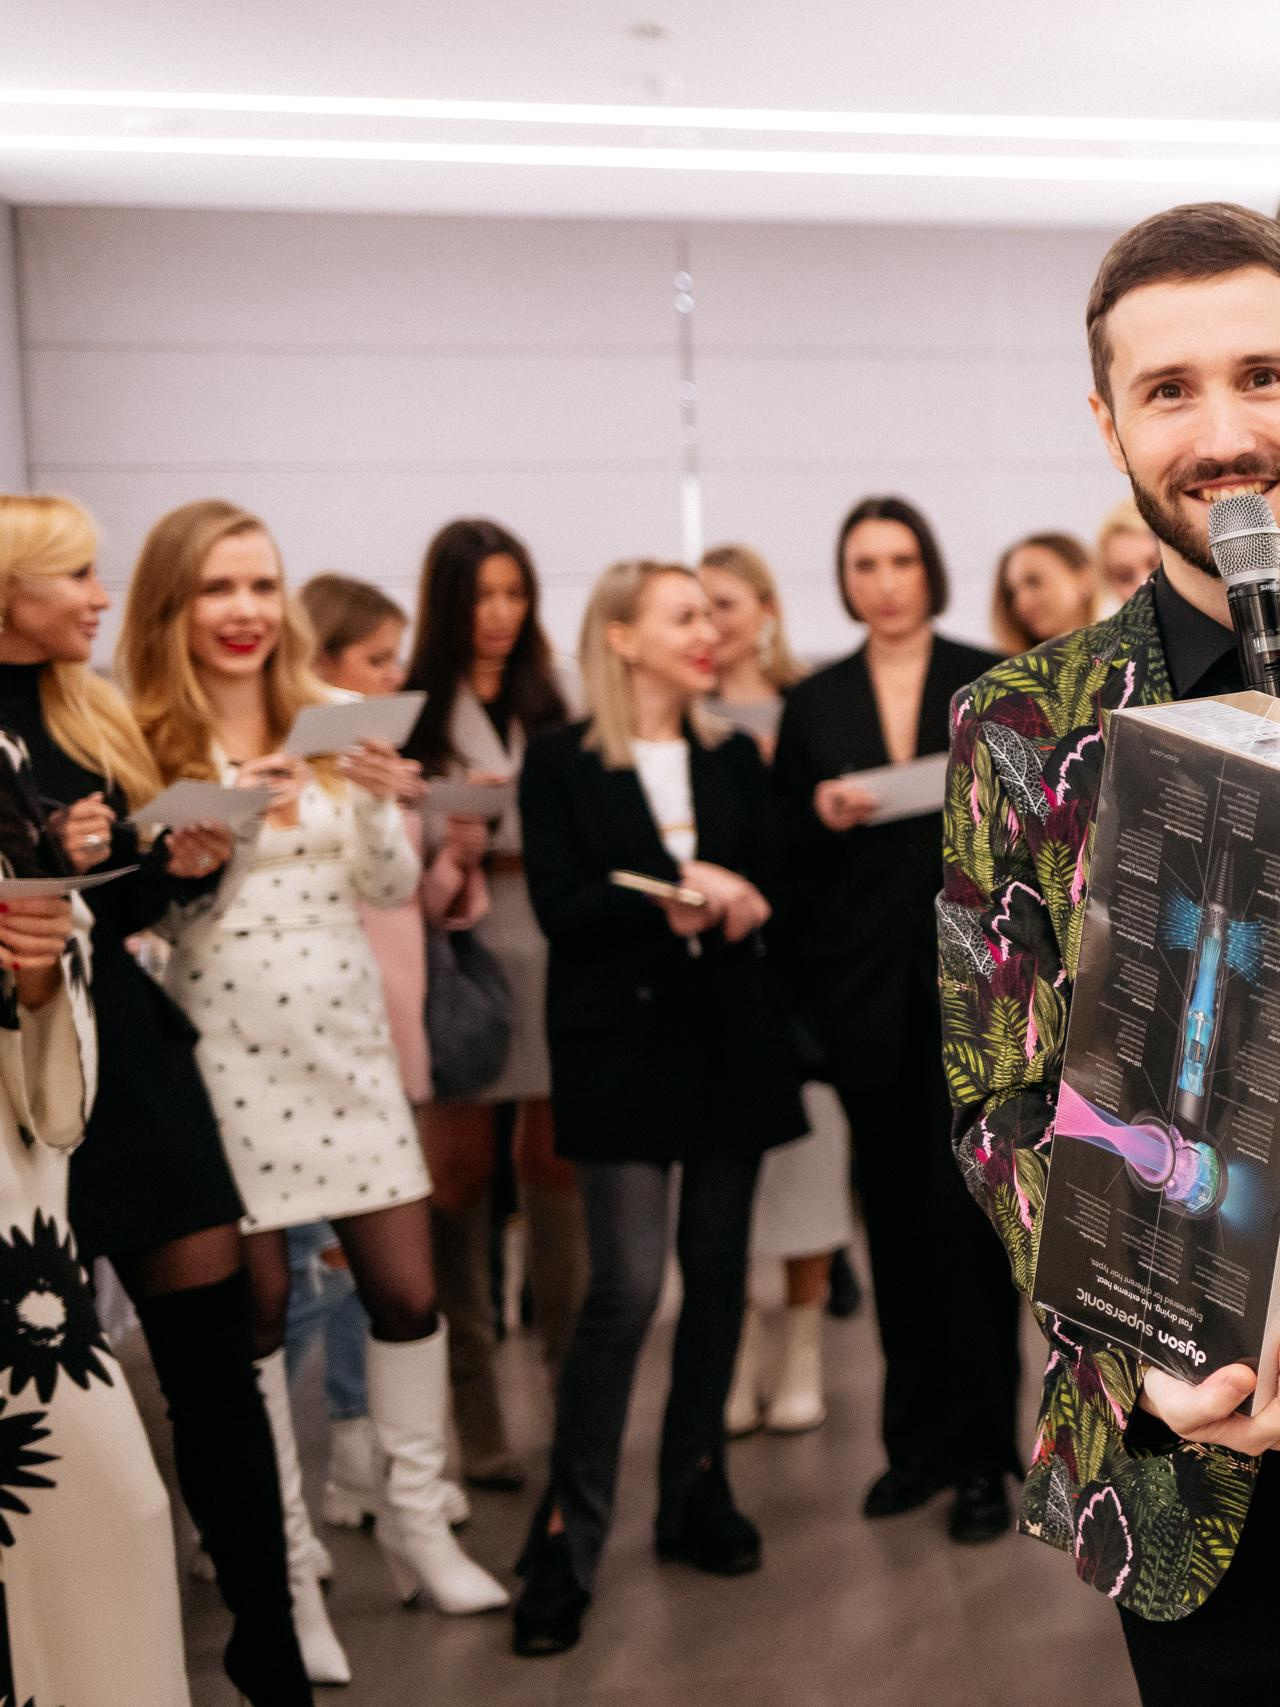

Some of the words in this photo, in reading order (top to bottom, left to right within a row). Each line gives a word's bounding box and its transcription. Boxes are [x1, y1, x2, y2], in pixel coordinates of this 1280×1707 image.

[1150, 748, 1180, 764] dyson.com
[1096, 1274, 1113, 1289] heat.
[1109, 1269, 1124, 1283] hair
[1113, 1283, 1140, 1302] extreme
[1123, 1276, 1152, 1296] different
[1140, 1298, 1153, 1310] No
[1152, 1291, 1164, 1303] for
[1077, 1288, 1153, 1336] supersonic
[1154, 1303, 1178, 1323] drying.
[1163, 1296, 1203, 1323] Engineered
[1178, 1317, 1193, 1332] Fast
[1158, 1330, 1207, 1366] dyson
